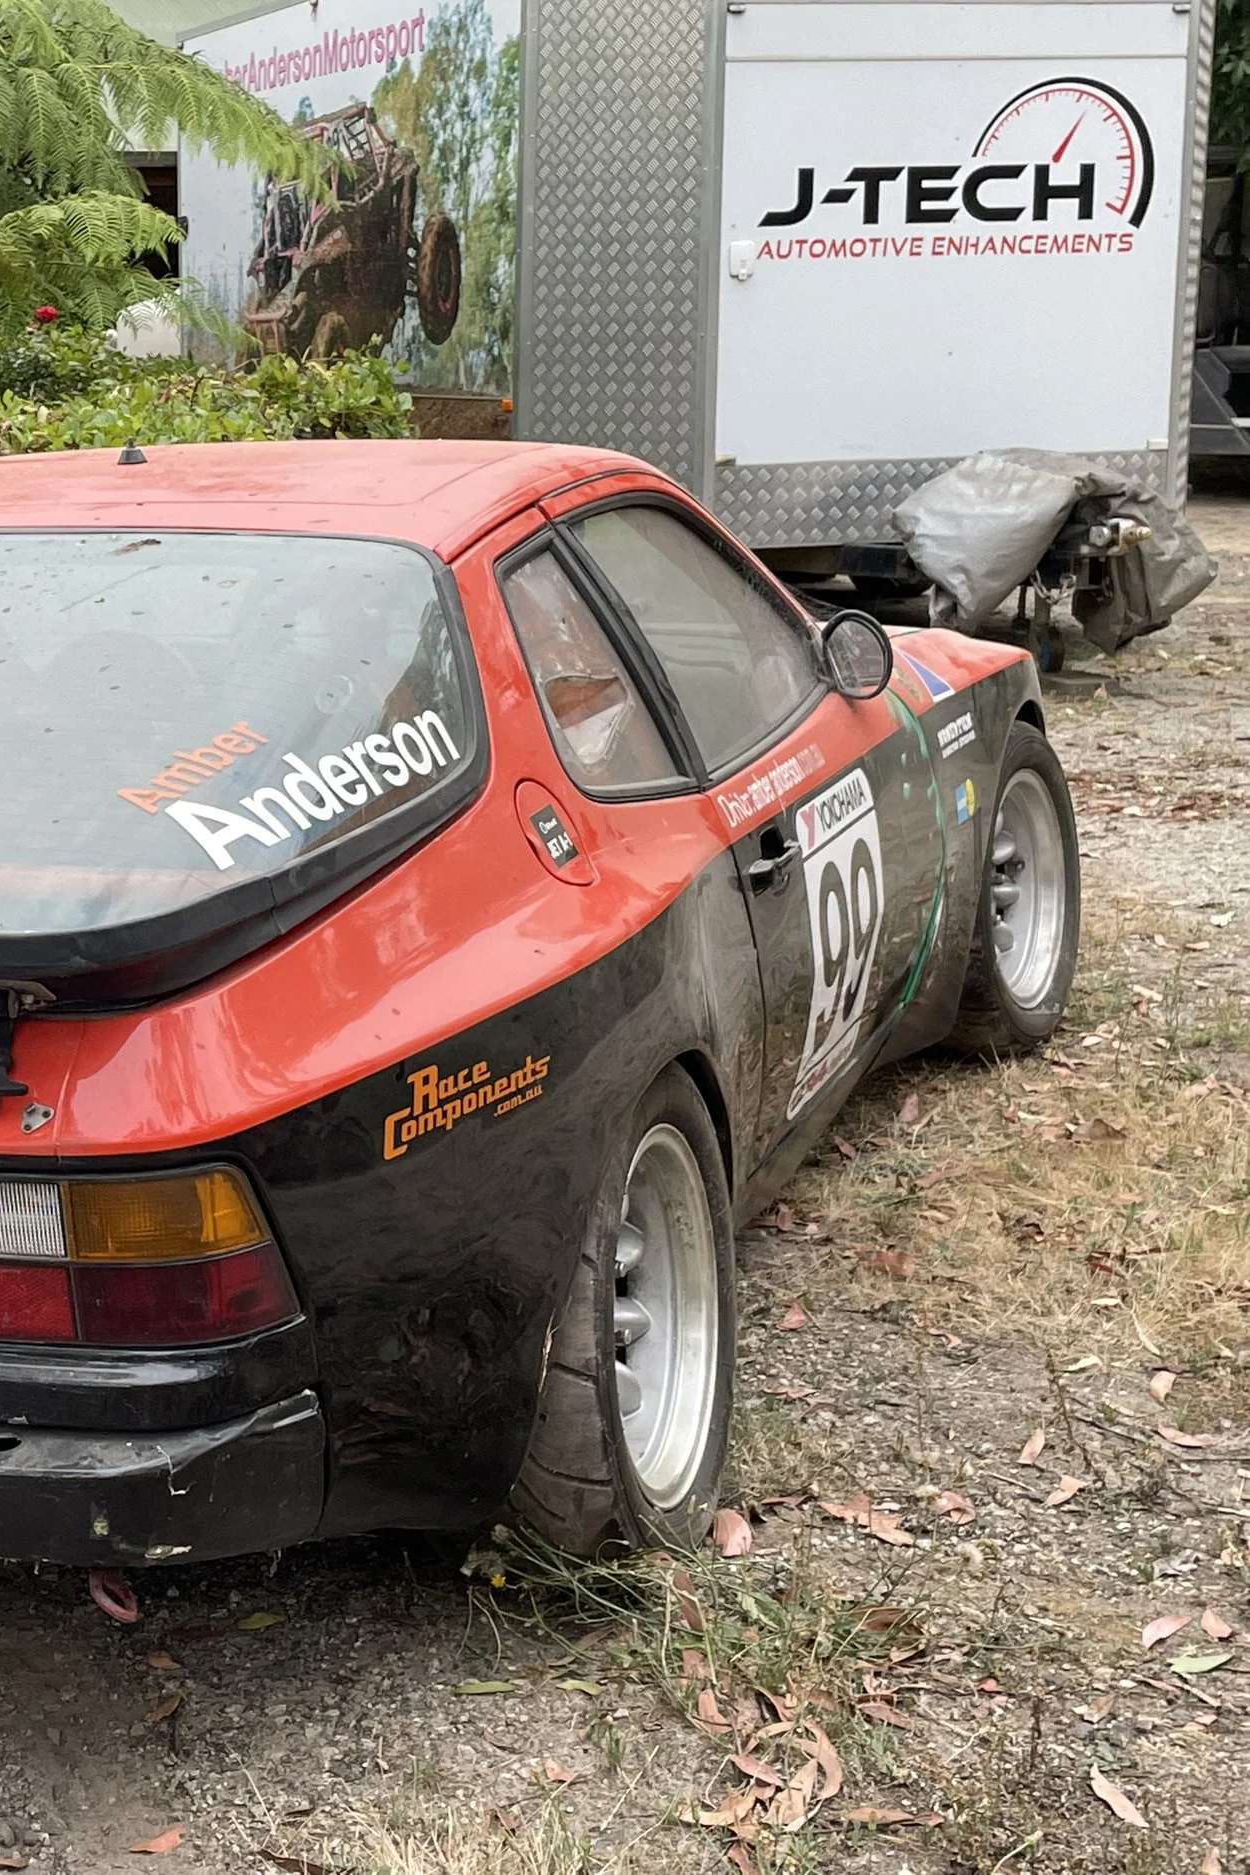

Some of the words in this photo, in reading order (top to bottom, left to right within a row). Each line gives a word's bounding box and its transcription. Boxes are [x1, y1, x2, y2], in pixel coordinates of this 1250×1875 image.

[756, 162, 1096, 228] J-TECH
[756, 236, 924, 260] AUTOMOTIVE
[931, 232, 1134, 256] ENHANCEMENTS
[116, 719, 270, 815] Amber
[164, 709, 462, 871] Anderson
[815, 777, 868, 833] YOKOHAMA
[804, 838, 878, 1066] 99
[383, 1055, 551, 1161] Components
[406, 1060, 492, 1117] Race
